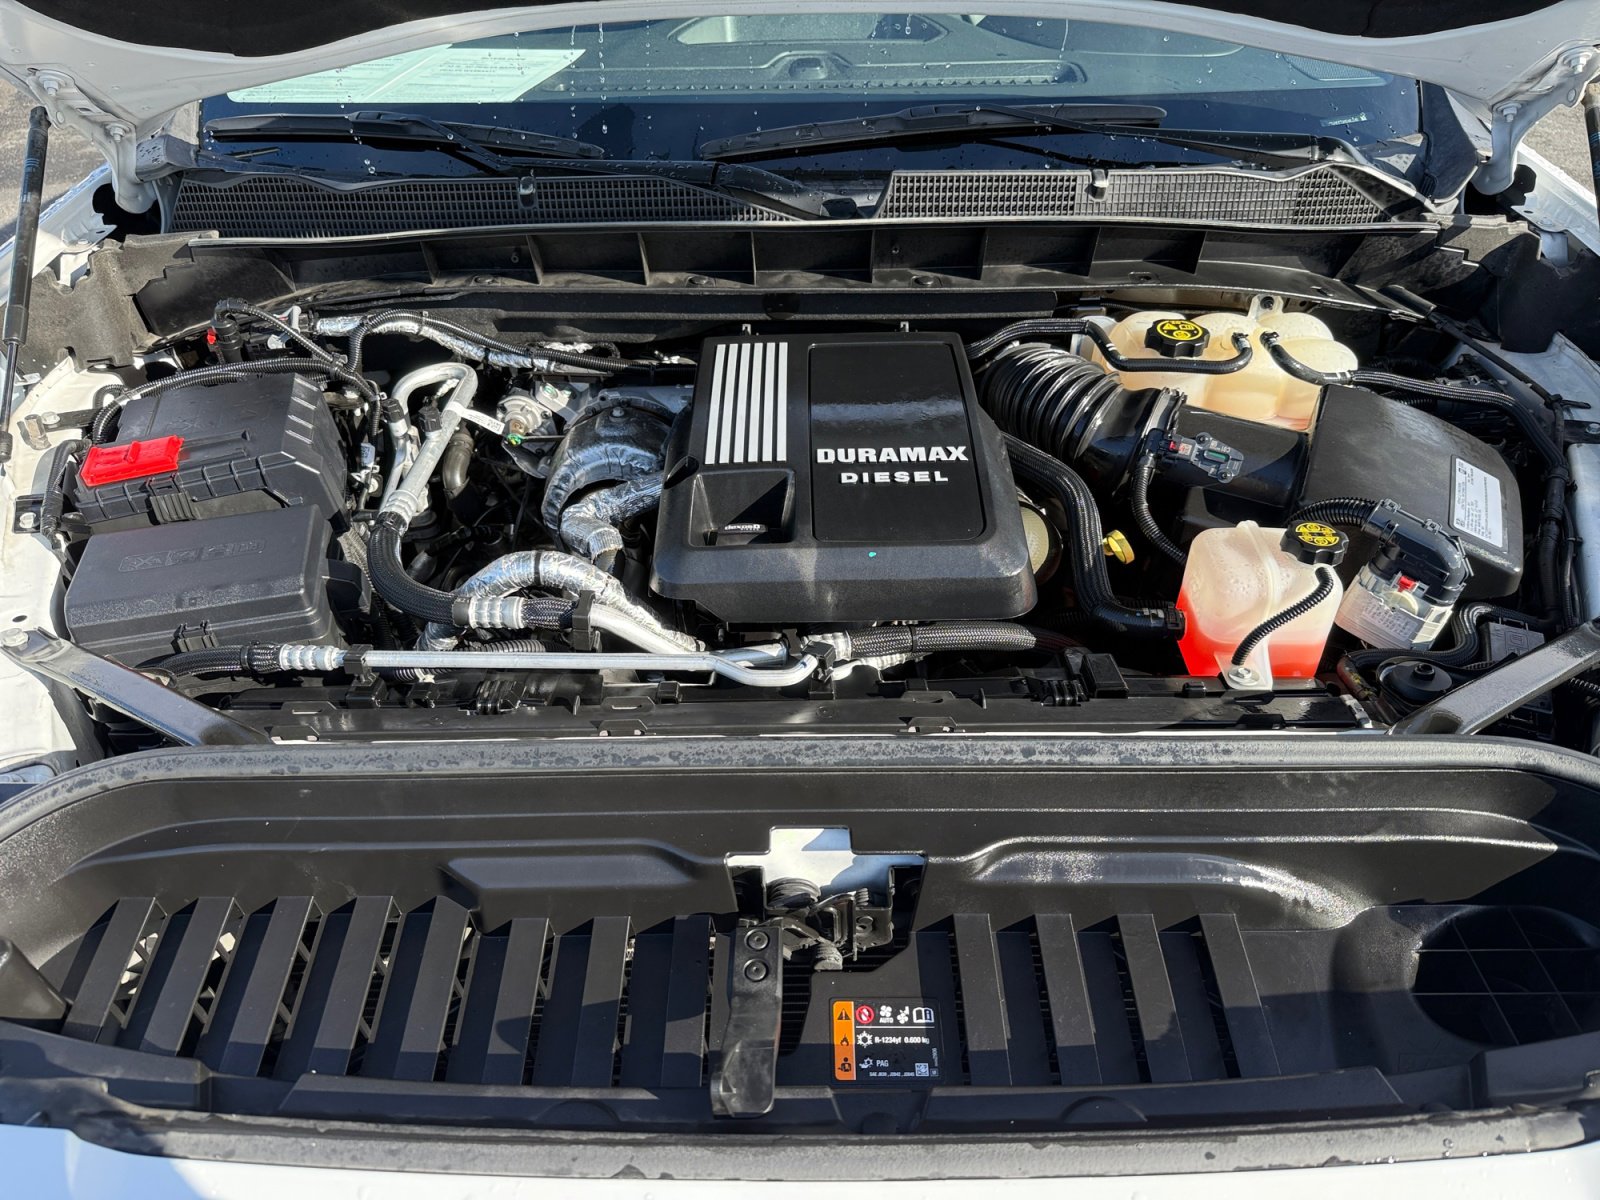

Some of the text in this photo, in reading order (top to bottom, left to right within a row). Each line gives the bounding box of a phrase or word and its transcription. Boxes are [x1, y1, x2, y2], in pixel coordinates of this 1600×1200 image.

[816, 446, 969, 464] DURAMAX
[840, 470, 949, 484] DIESEL
[874, 1036, 902, 1045] R-1234yf
[921, 1036, 930, 1045] kg
[876, 1059, 889, 1067] PAG
